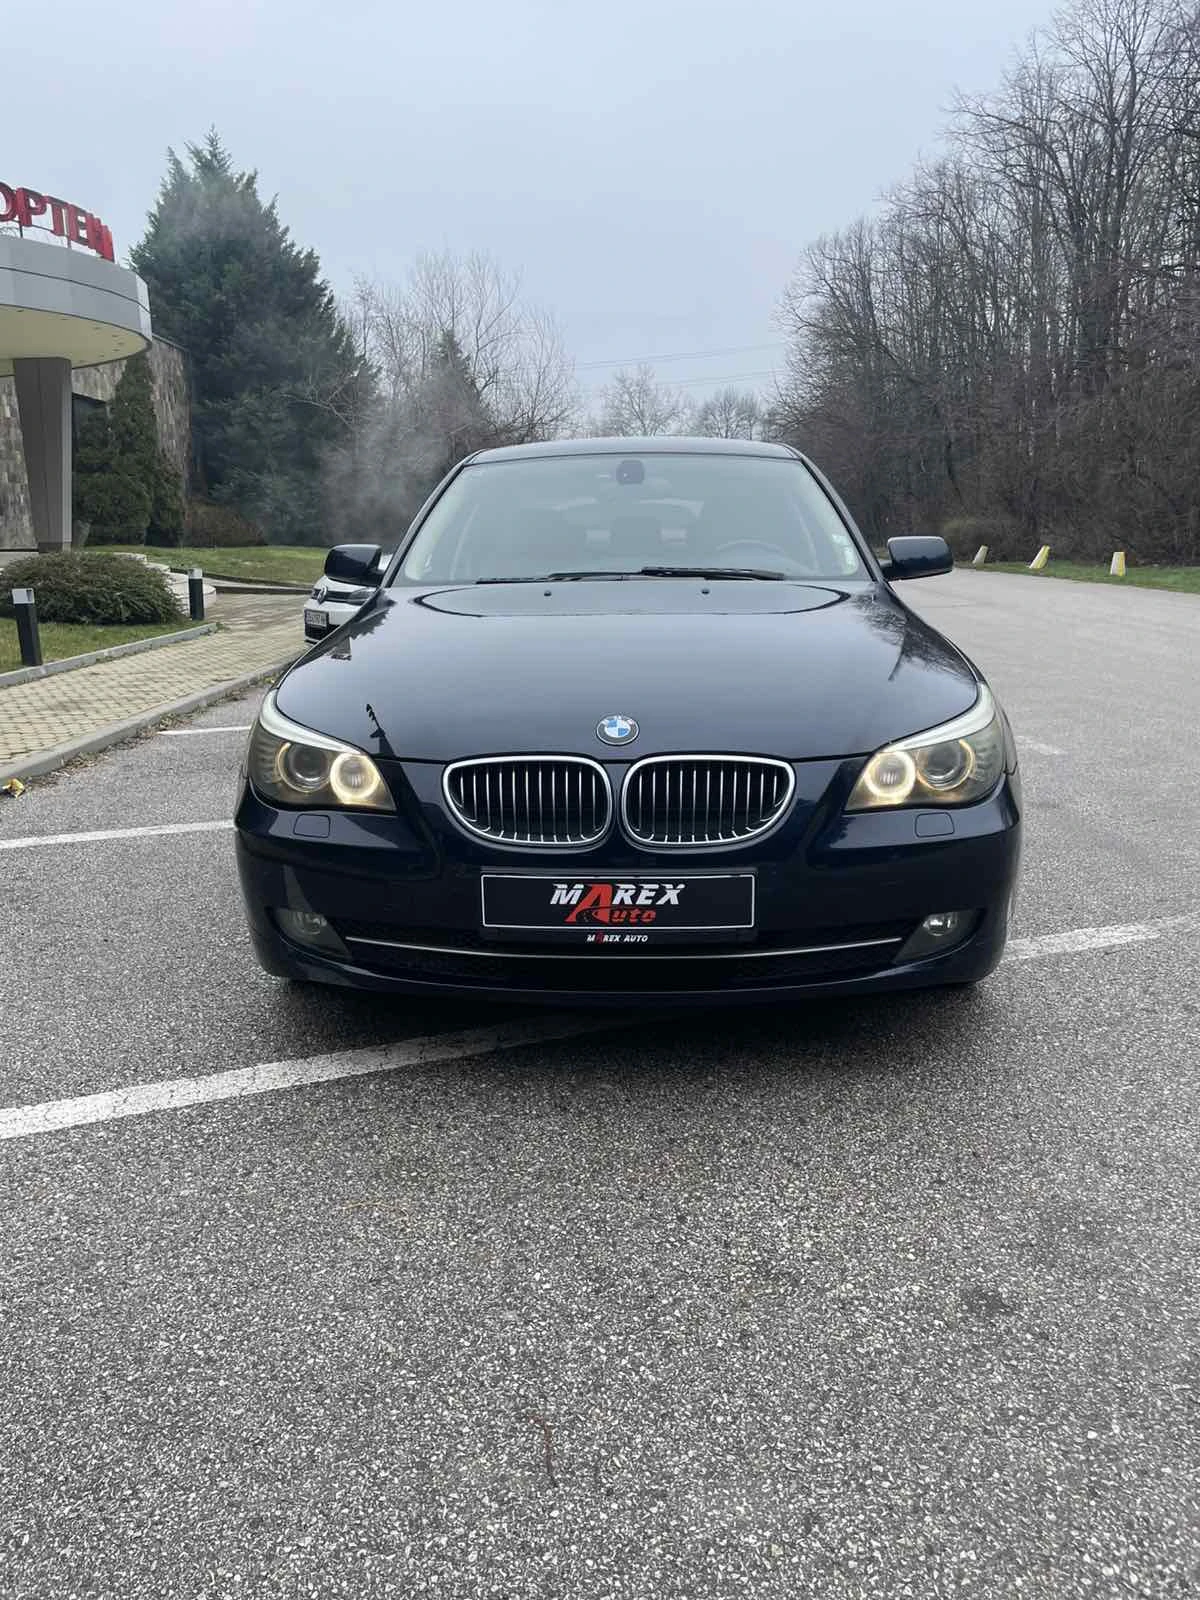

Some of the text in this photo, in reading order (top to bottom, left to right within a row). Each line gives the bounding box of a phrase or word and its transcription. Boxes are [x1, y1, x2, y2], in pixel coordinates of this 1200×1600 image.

[550, 882, 686, 907] MAREX
[586, 931, 649, 944] MAREX AUTO
